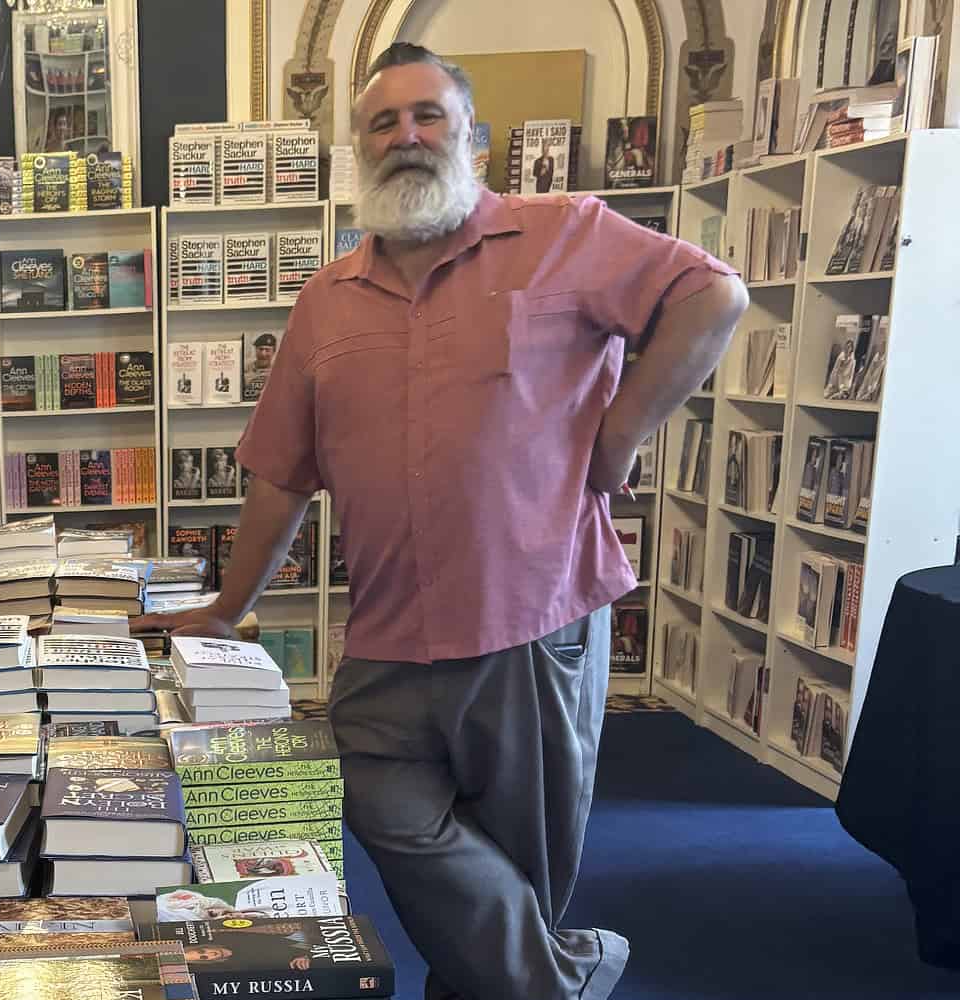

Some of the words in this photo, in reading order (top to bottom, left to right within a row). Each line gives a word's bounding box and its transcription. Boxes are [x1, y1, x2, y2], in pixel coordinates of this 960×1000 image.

[224, 140, 263, 150] Stephen
[276, 137, 316, 148] Stephen
[173, 151, 206, 160] Sackur
[224, 149, 256, 158] Sackur
[276, 146, 309, 156] Sackur
[609, 169, 652, 178] GENERALS
[182, 241, 218, 250] Stephen
[226, 239, 266, 249] Stephen
[280, 237, 318, 248] Stephen
[182, 250, 214, 258] Sackur
[226, 248, 259, 257] Sackur
[280, 246, 312, 255] Sackur
[12, 260, 53, 272] Cleeves
[198, 264, 220, 272] HARD
[128, 363, 145, 371] Ann
[182, 768, 213, 782] Ann
[217, 765, 284, 781] Cleeves
[186, 789, 218, 803] Ann
[222, 786, 288, 802] Cleeves
[186, 811, 217, 825] Ann
[220, 808, 287, 823] Cleeves
[317, 918, 362, 963] RUSSIA
[310, 945, 330, 959] My
[212, 982, 240, 995] MY
[248, 979, 314, 994] RUSSIA
